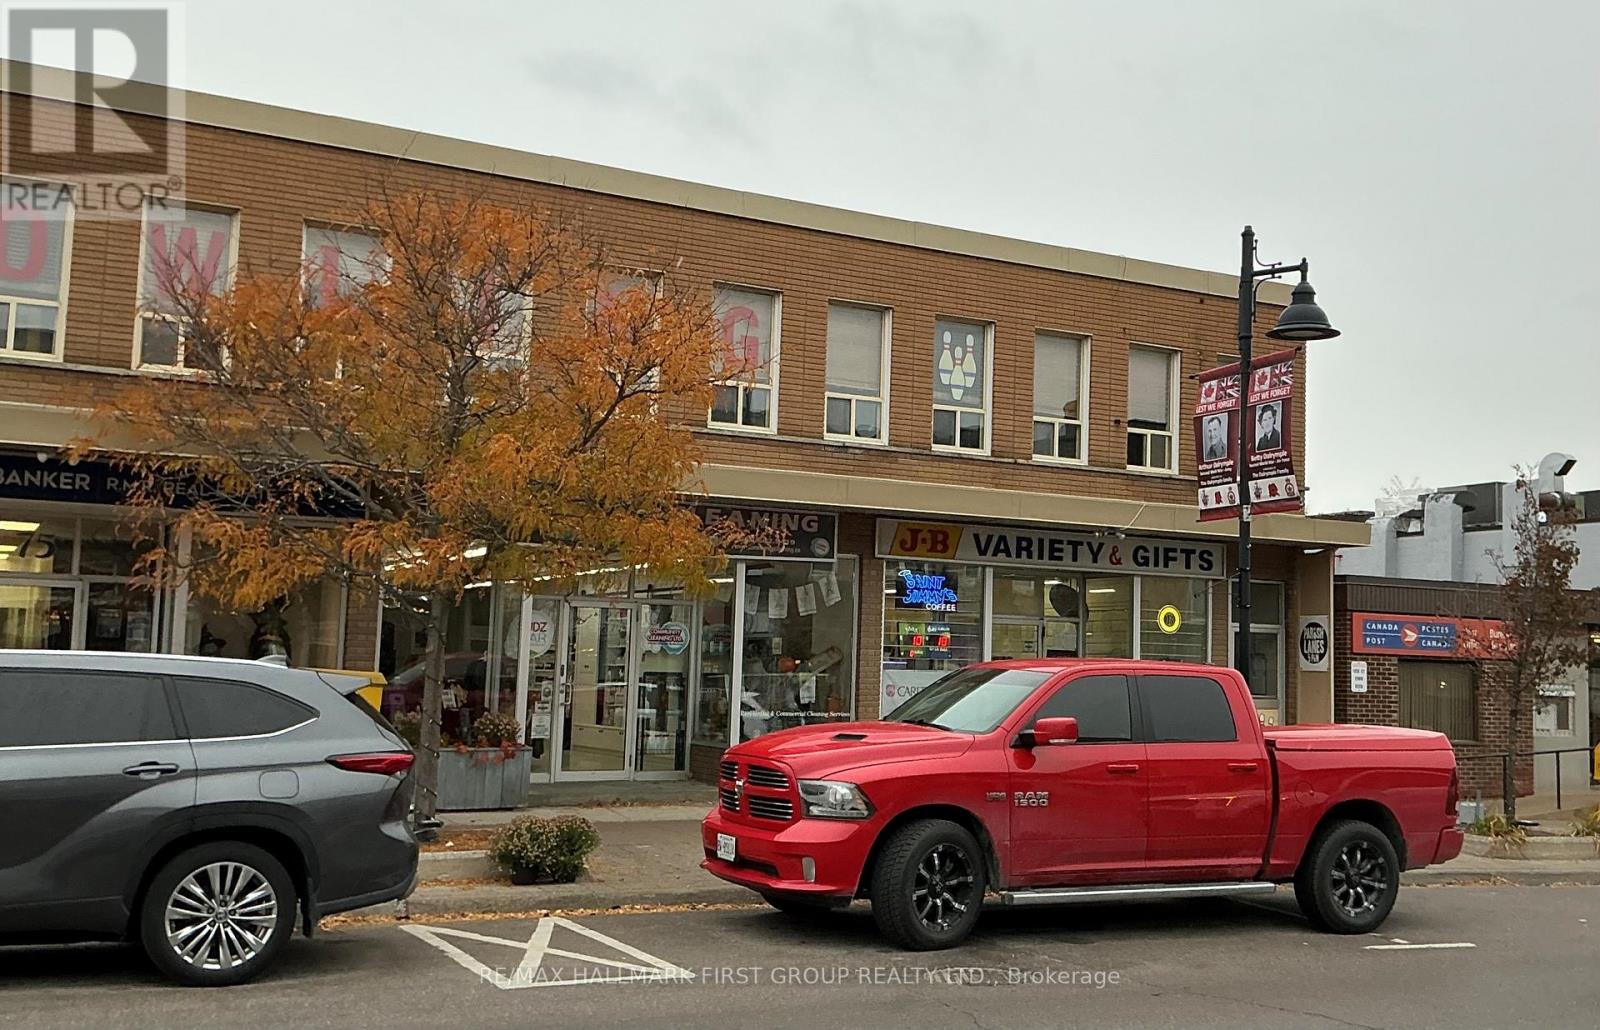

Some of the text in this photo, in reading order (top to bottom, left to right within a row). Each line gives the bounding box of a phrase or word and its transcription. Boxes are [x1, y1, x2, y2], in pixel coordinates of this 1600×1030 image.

[1261, 391, 1270, 400] WE
[1270, 386, 1291, 399] FORGET
[1207, 402, 1217, 411] WE
[1217, 399, 1236, 409] FORGET
[16, 532, 55, 559] 75
[973, 532, 1104, 565] VARIETY
[1109, 544, 1123, 566] &
[1132, 545, 1215, 572] GIFTS
[902, 572, 946, 589] SAINT
[903, 587, 958, 605] JIMMY'S
[925, 603, 957, 612] COFFEE
[1366, 622, 1399, 631] CANADA
[1421, 625, 1449, 634] POSTES
[1366, 637, 1386, 645] POST
[1421, 639, 1451, 648] CANAD
[1303, 639, 1325, 654] LANES
[1014, 791, 1049, 799] RAM
[1014, 799, 1049, 807] 1500
